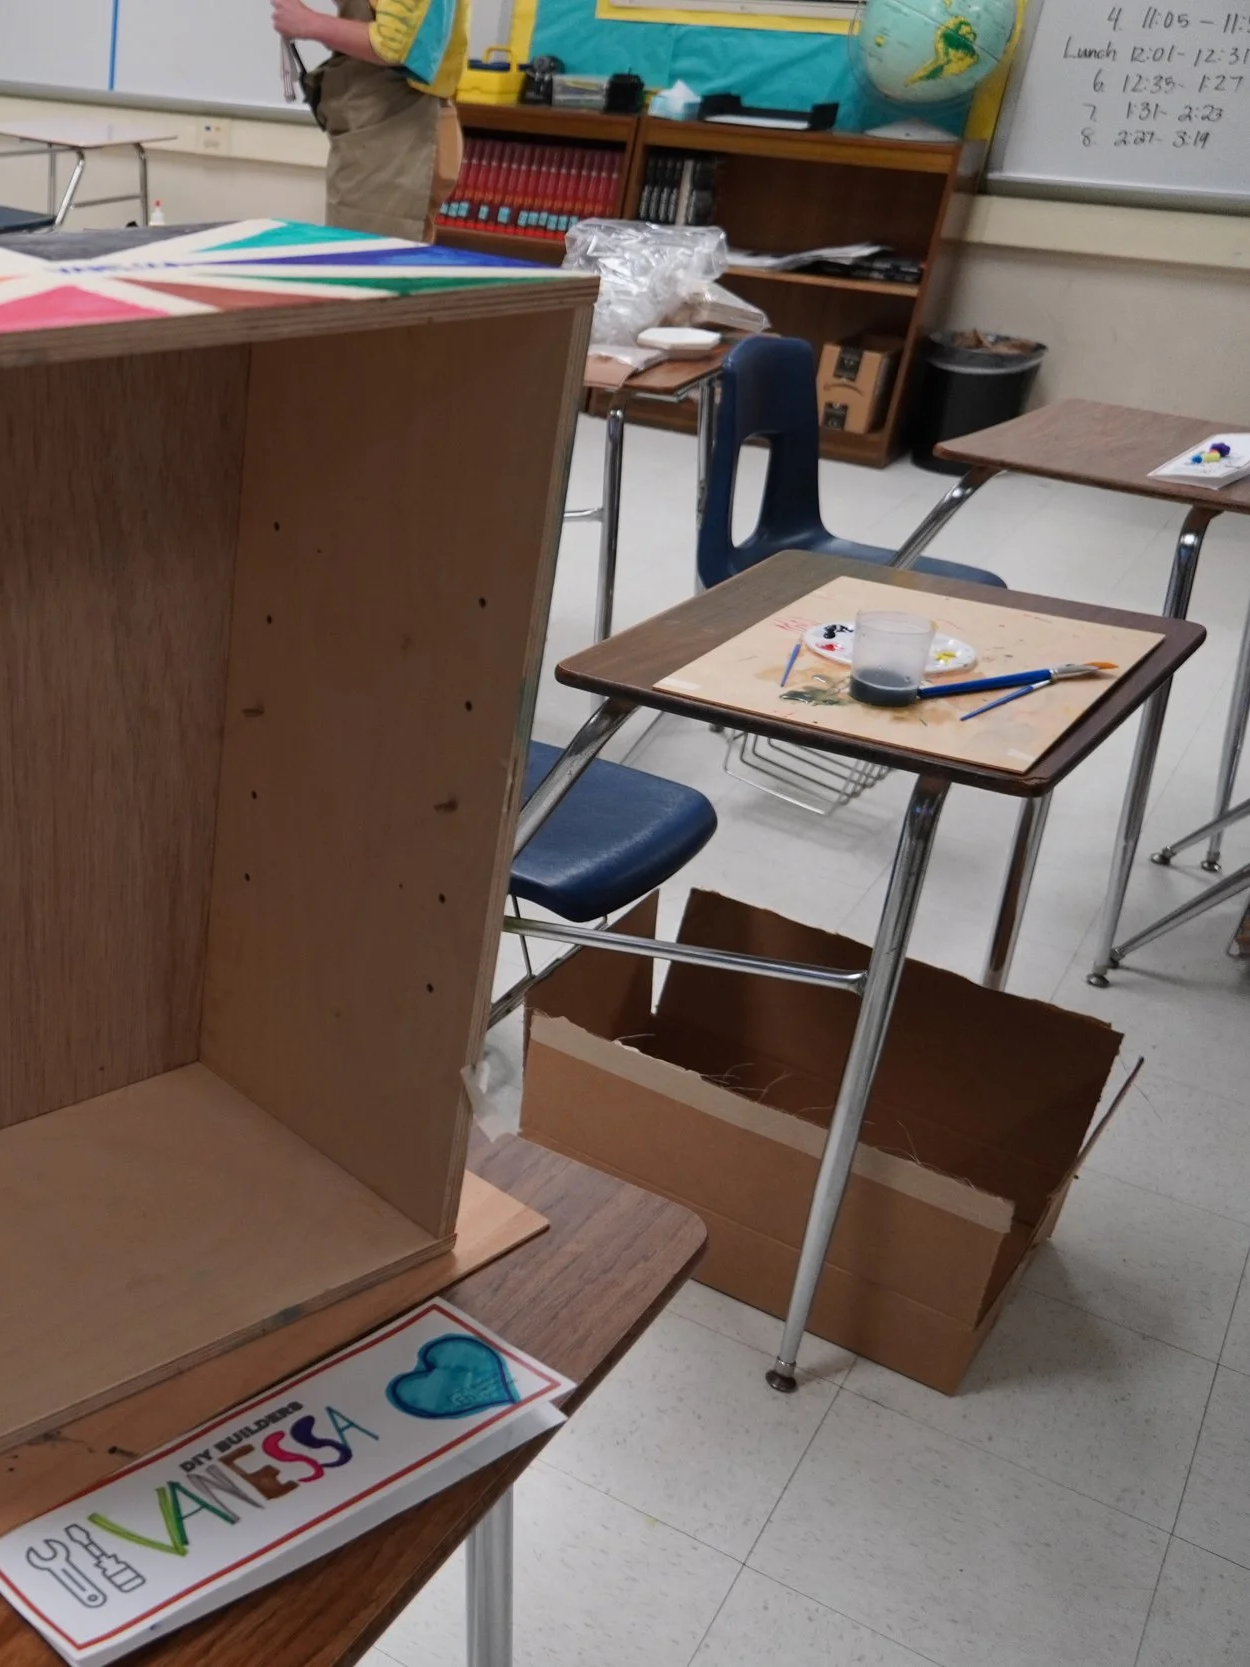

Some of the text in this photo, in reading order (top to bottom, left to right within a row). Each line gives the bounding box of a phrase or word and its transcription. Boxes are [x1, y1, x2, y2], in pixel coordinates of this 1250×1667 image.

[1141, 6, 1190, 29] 11:05
[1063, 35, 1117, 62] Lunch
[1193, 46, 1250, 67] 12:31
[1198, 74, 1244, 93] 1:27
[1177, 104, 1223, 122] 2:23
[1172, 131, 1210, 149] 3:19
[179, 1401, 304, 1474] DIY BUILDERS
[87, 1405, 380, 1557] VANESSA
